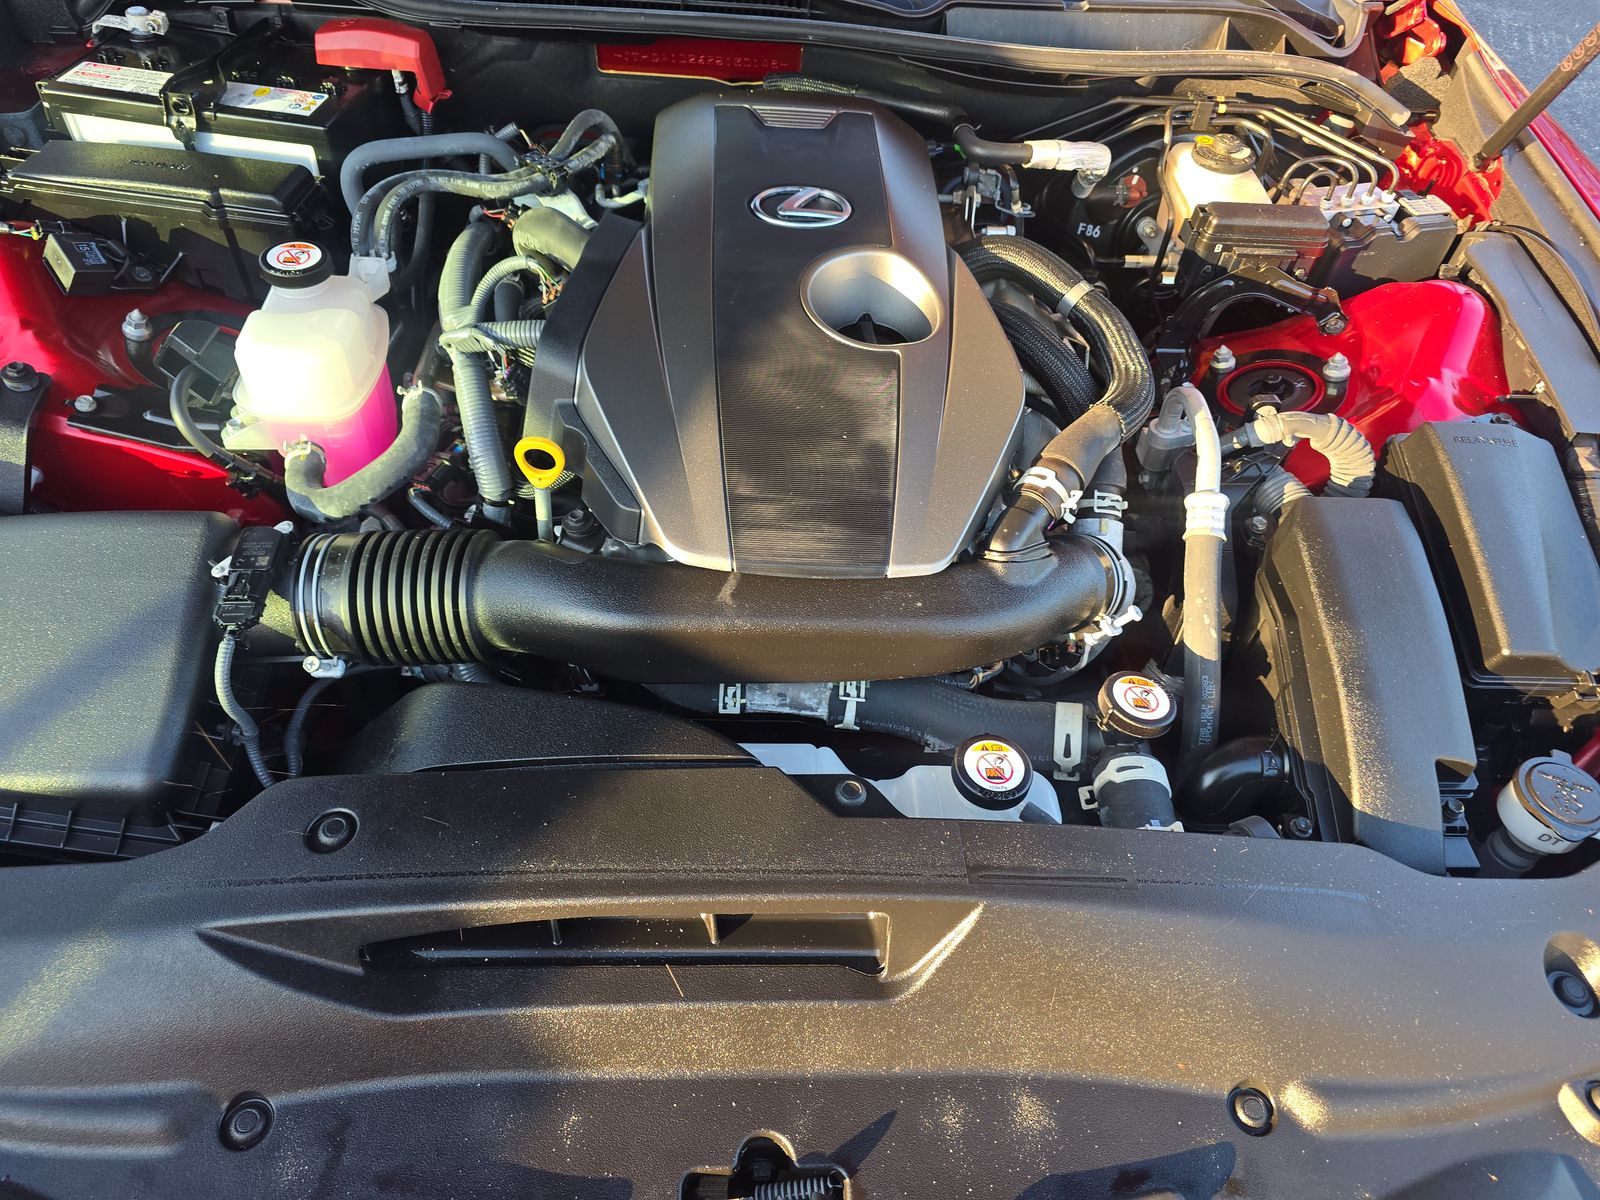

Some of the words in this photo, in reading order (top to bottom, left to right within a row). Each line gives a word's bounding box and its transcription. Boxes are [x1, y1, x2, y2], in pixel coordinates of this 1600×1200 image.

[1077, 222, 1101, 237] F86
[1213, 244, 1223, 253] B
[1537, 833, 1564, 846] DT
